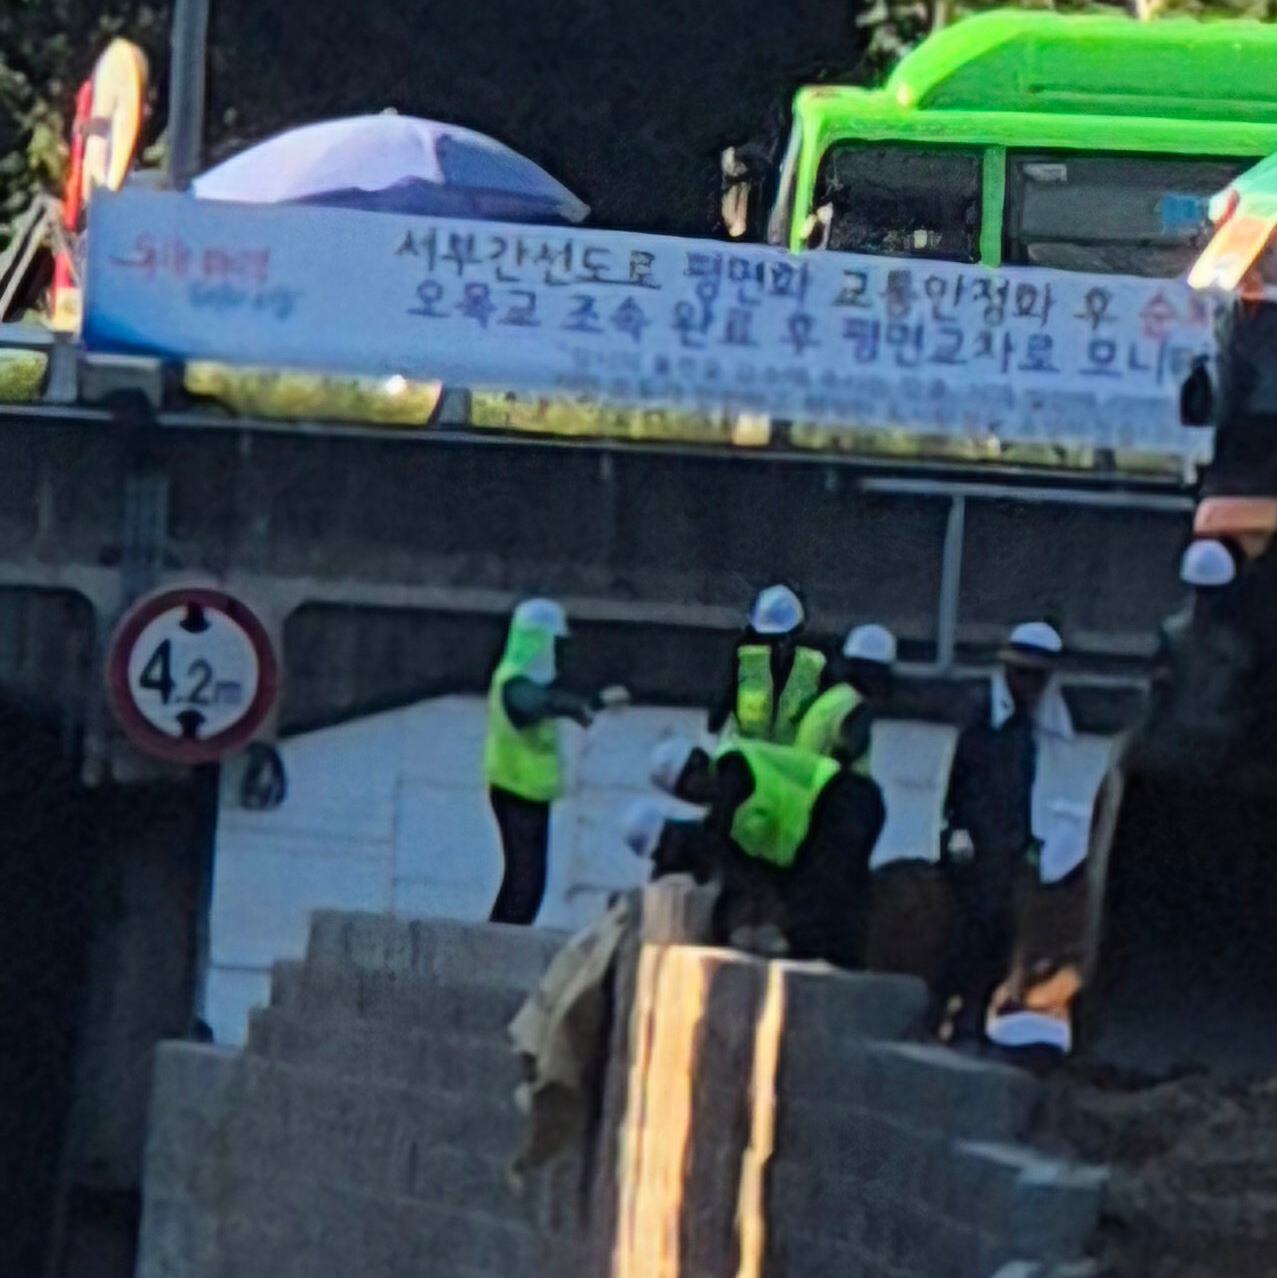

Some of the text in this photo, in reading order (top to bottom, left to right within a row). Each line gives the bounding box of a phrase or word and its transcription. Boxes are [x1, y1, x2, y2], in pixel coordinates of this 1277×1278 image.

[394, 226, 662, 291] 서부간선도로
[683, 251, 811, 307] 평면화
[1072, 286, 1119, 331] 후
[406, 278, 543, 330] 오목교
[779, 311, 821, 357] 후
